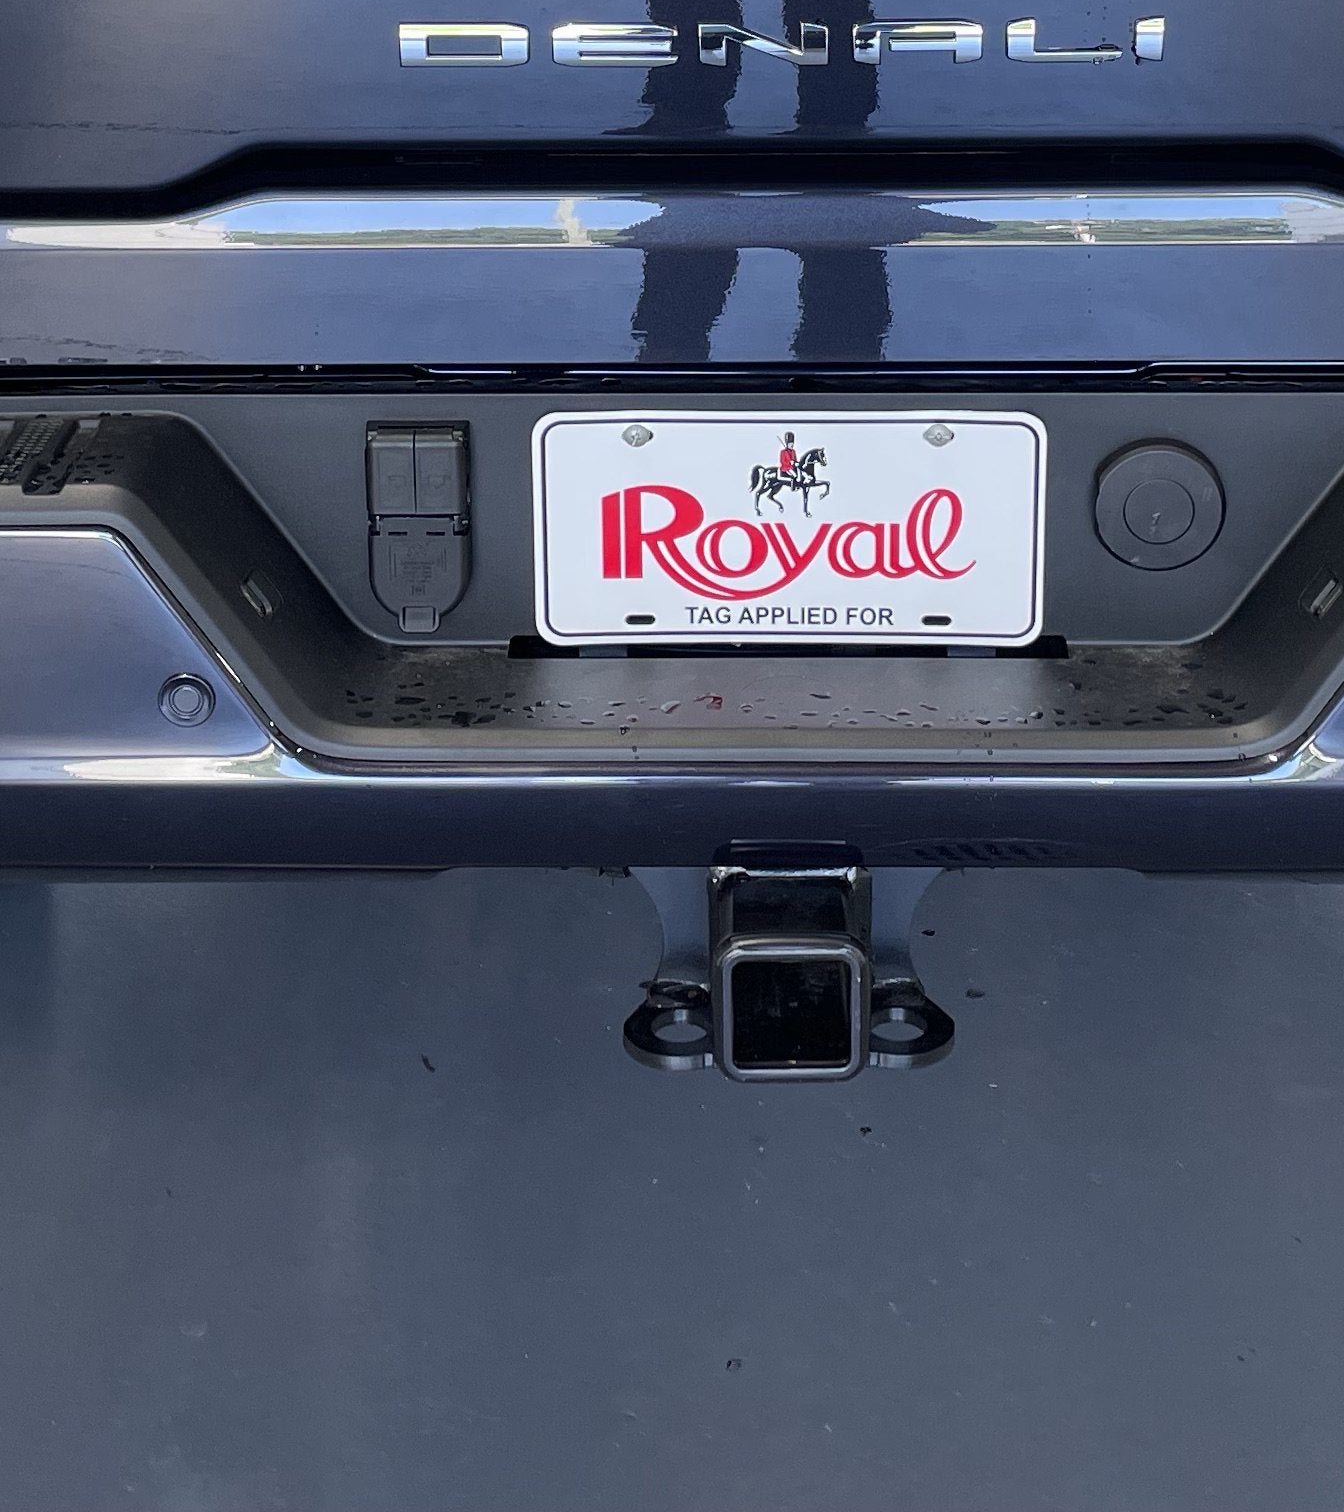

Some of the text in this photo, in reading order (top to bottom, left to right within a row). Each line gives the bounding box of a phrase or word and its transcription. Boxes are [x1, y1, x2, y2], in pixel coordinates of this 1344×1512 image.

[398, 16, 1167, 68] DENALI
[601, 485, 976, 601] Royal
[685, 606, 894, 626] TAG APPLIED FOR
